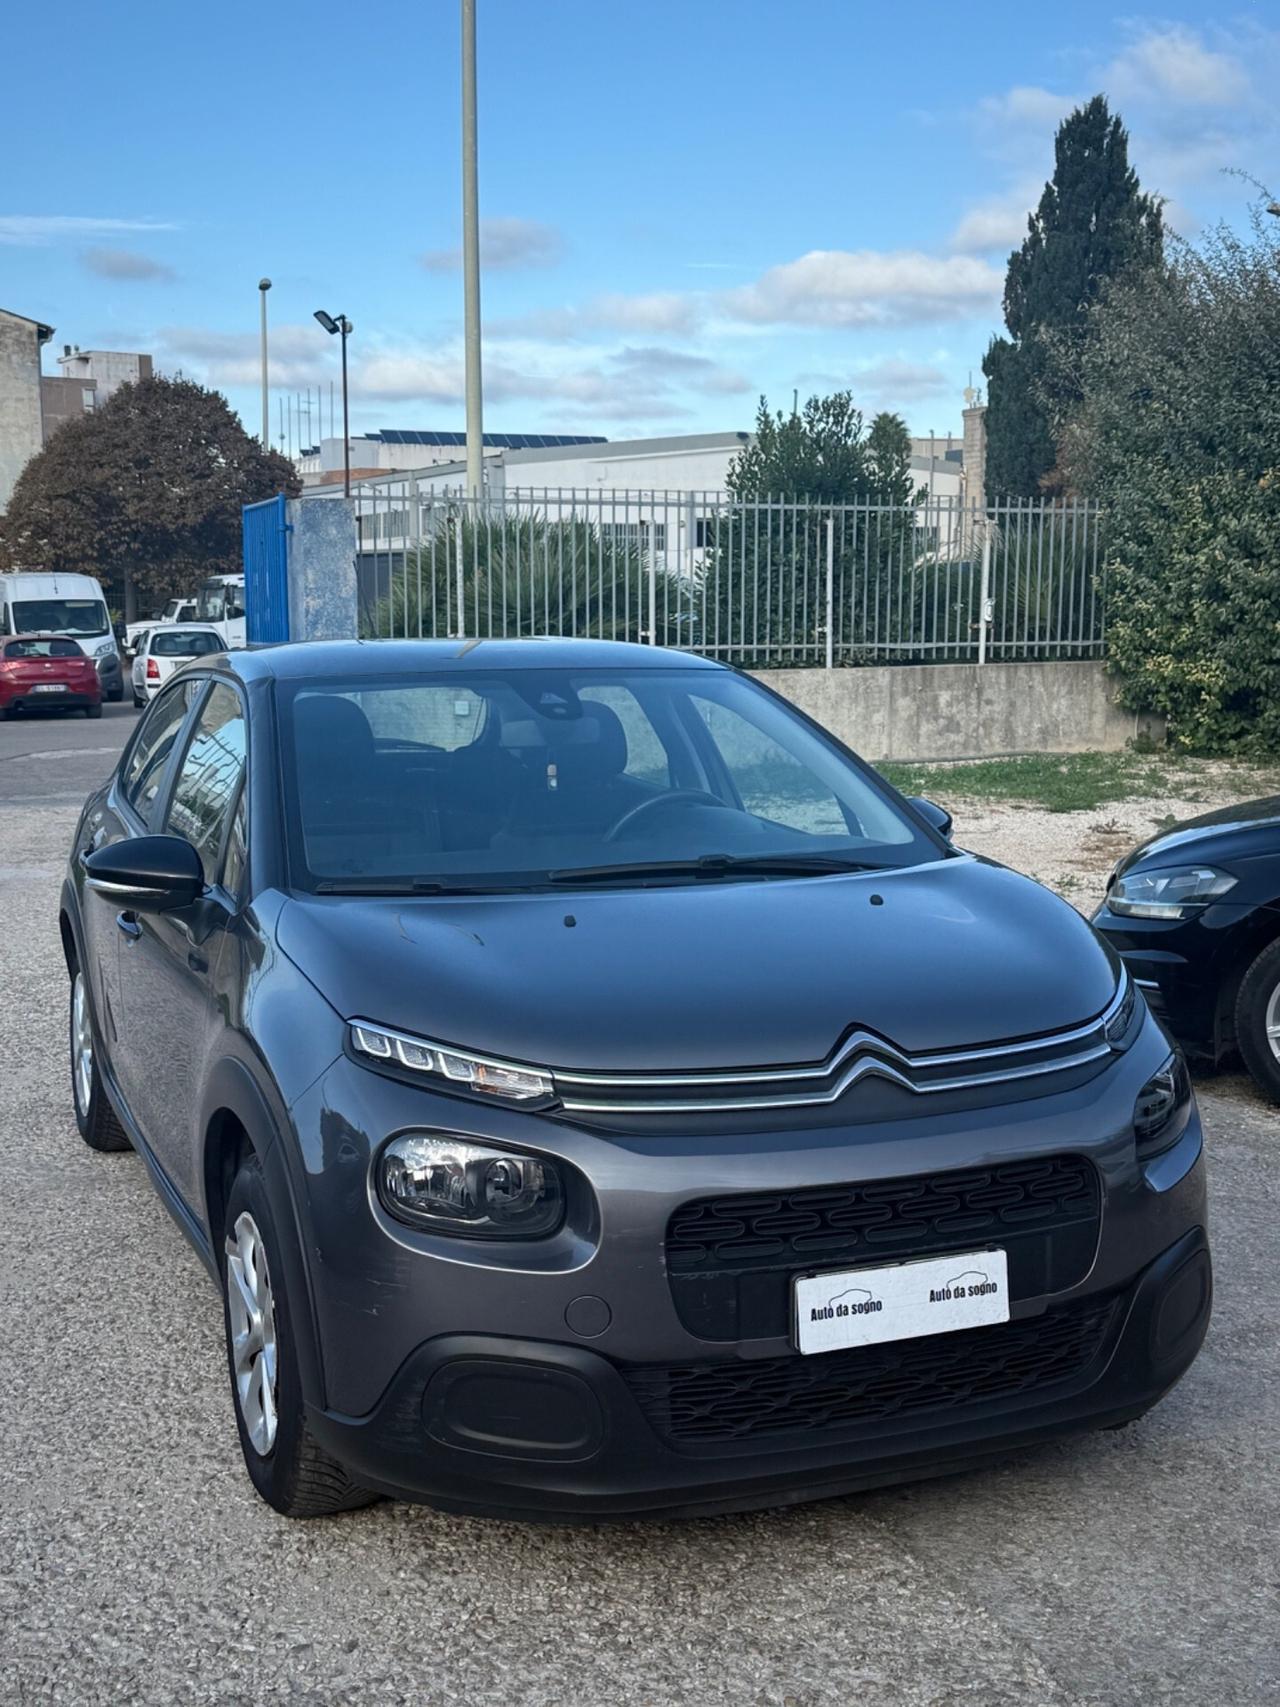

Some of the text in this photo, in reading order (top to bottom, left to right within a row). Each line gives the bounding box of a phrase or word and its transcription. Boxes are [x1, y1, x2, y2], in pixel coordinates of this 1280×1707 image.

[929, 1282, 998, 1303] Auto da sogno
[811, 1300, 883, 1321] Auto da sogno
